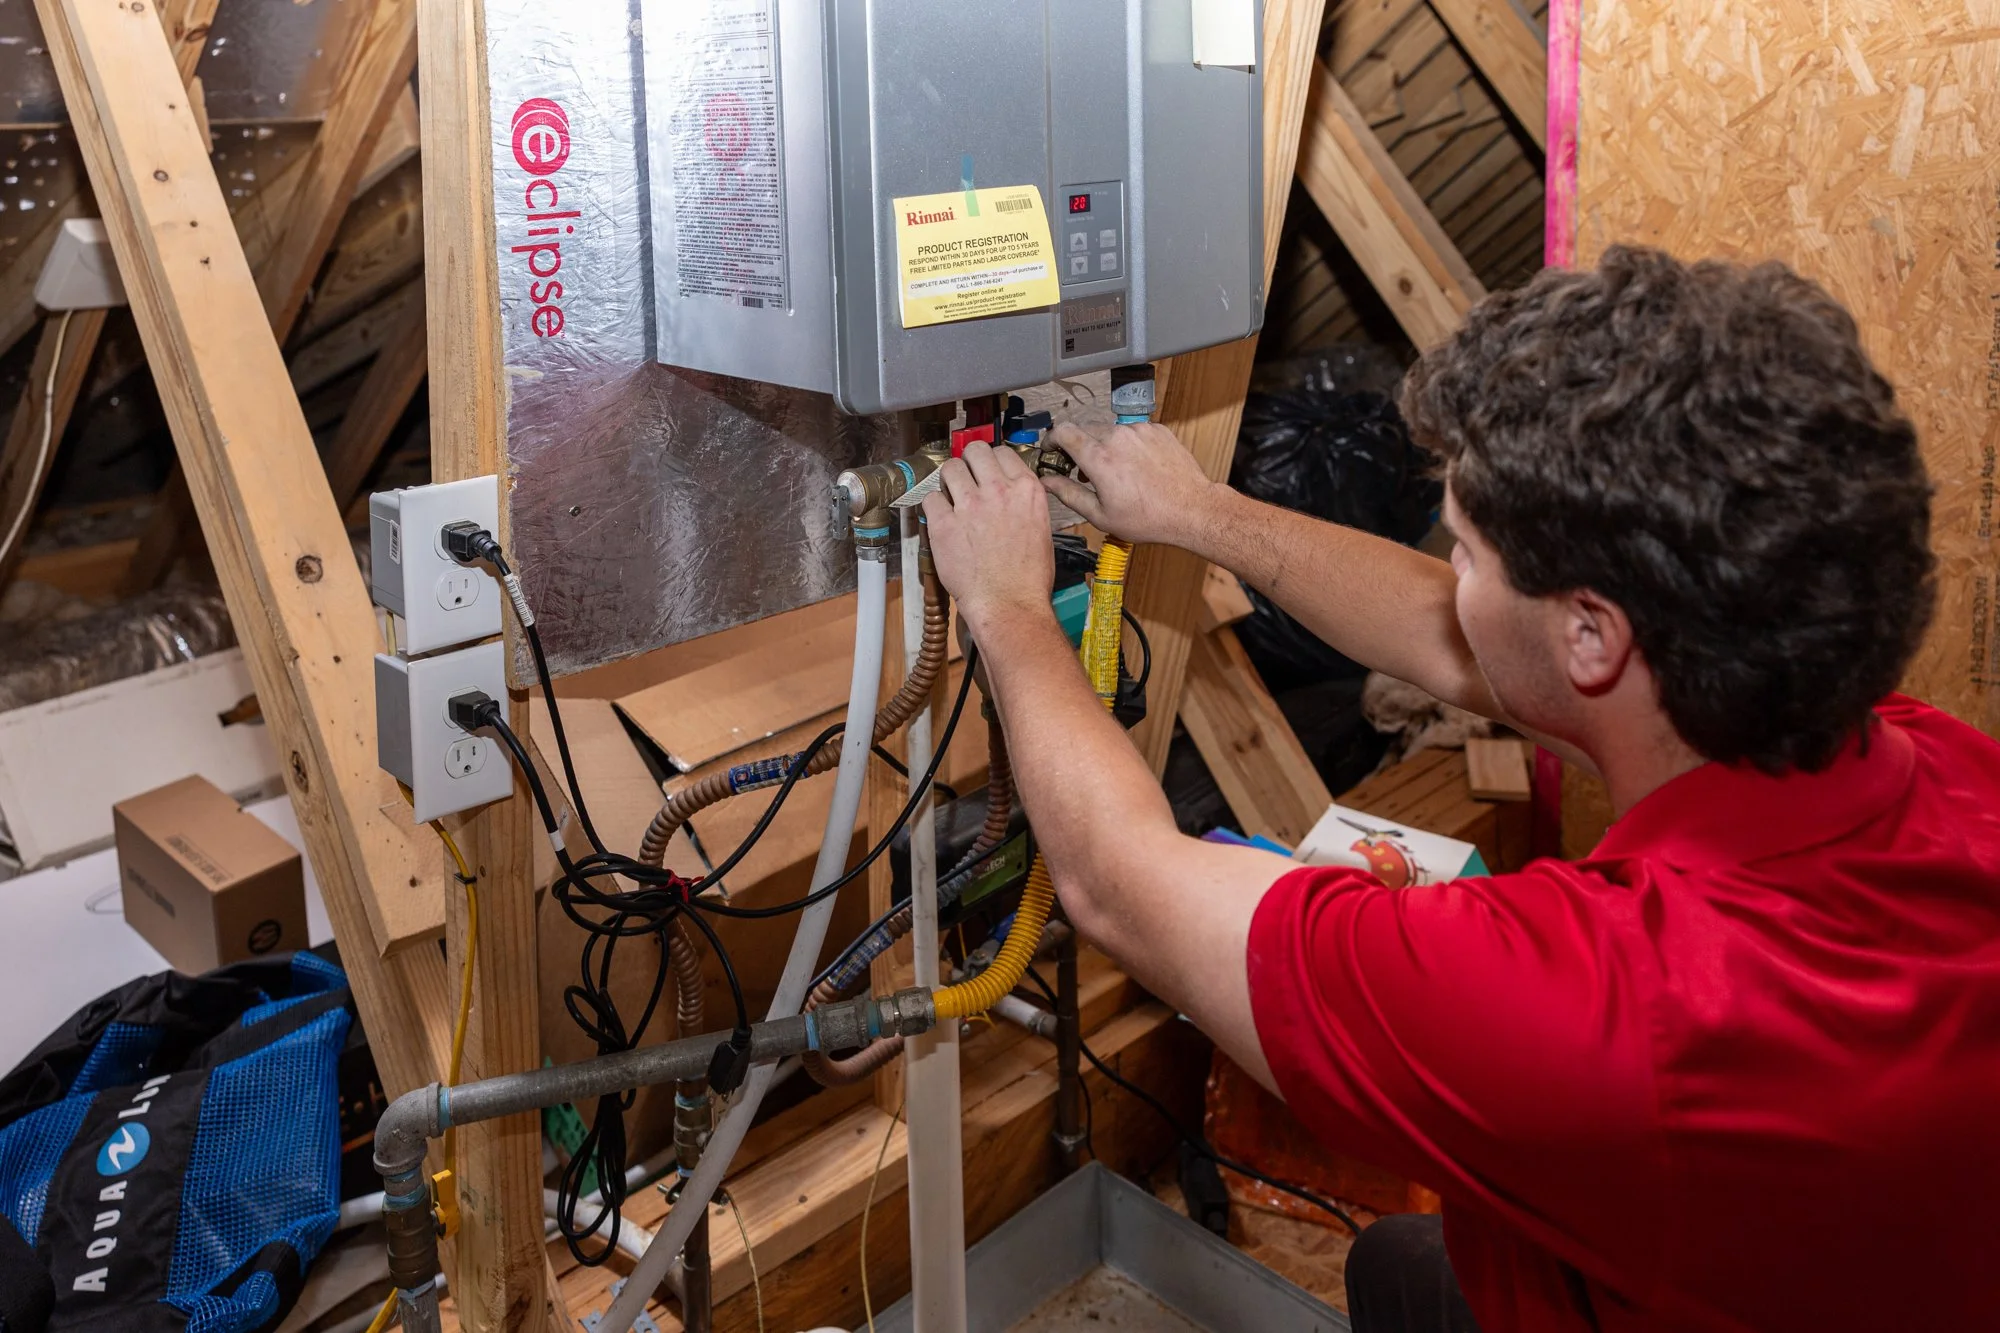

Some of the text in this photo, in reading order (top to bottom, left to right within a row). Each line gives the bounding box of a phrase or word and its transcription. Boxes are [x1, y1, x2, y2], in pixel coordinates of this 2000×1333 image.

[906, 207, 955, 226] Rinnai
[909, 256, 939, 266] RESPOND
[940, 253, 960, 261] WITHIN
[970, 249, 985, 257] DAYS
[986, 247, 998, 255] FOR
[999, 245, 1007, 253] UP
[1021, 241, 1039, 249] YEARS
[918, 232, 1029, 256] PRODUCT REGISTRATION
[928, 263, 951, 272] LIMITED
[953, 260, 972, 268] PARTS
[986, 255, 1007, 263] LABOR
[910, 281, 938, 289] COMPLETE
[1018, 265, 1038, 274] purchase
[957, 291, 980, 300] Register
[1064, 298, 1122, 327] Rinnai
[73, 1180, 128, 1292] AQUA
